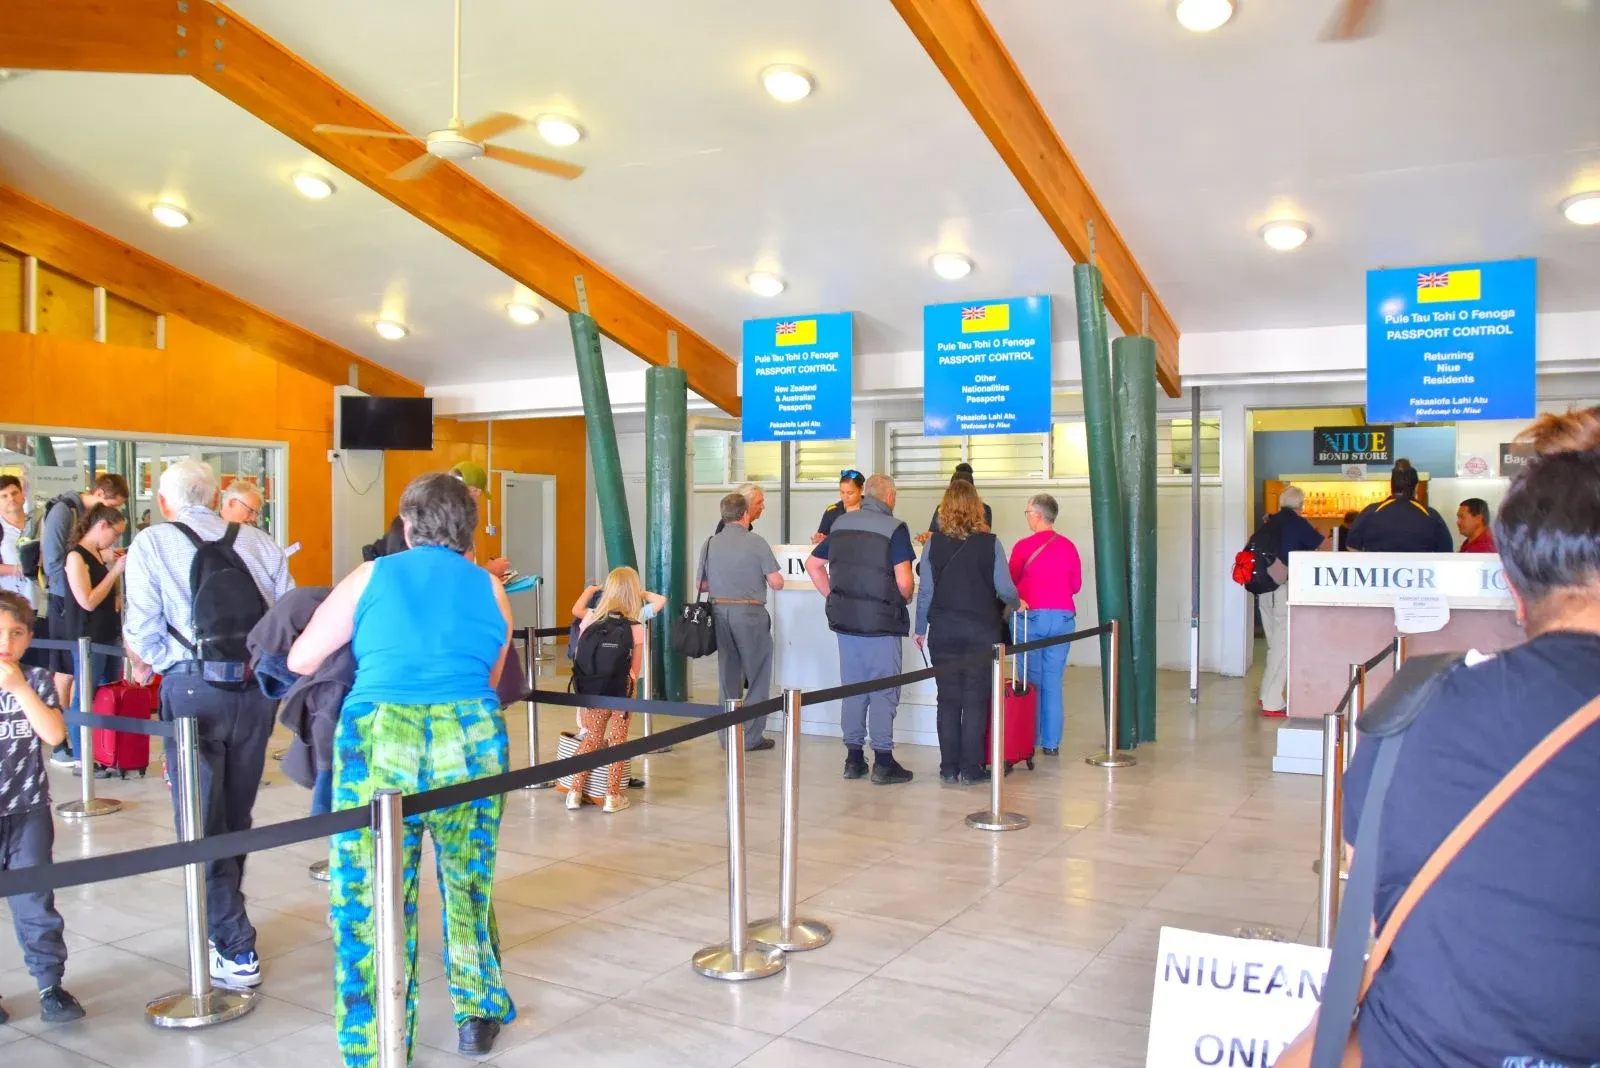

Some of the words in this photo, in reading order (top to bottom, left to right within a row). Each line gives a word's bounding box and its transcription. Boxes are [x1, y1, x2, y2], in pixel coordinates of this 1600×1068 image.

[1411, 313, 1430, 323] Tau
[1432, 311, 1456, 322] Tohi
[1459, 310, 1469, 320] O
[1472, 308, 1515, 320] Fenoga
[1386, 328, 1449, 340] PASSPORT
[1453, 325, 1513, 337] CONTROL
[957, 341, 971, 350] Tau
[973, 340, 991, 348] Tohi
[993, 339, 1000, 347] O
[1003, 338, 1035, 348] Fenoga
[785, 353, 801, 361] Tohi
[802, 352, 809, 360] O
[810, 351, 839, 360] Fenoga
[939, 354, 987, 365] PASSPORT
[988, 351, 1034, 362] CONTROL
[1424, 350, 1474, 361] Returning
[756, 366, 796, 376] PASSPORT
[798, 364, 837, 374] CONTROL
[1437, 364, 1460, 372] Niue
[975, 374, 996, 382] Other
[1423, 375, 1474, 385] Residents
[775, 385, 788, 393] New
[790, 384, 817, 392] Zealand
[962, 384, 1010, 393] Nationalities
[782, 394, 815, 402] Australian
[966, 394, 1006, 404] Passports
[1452, 396, 1471, 405] Lahi
[1473, 396, 1488, 404] Atu
[778, 404, 812, 412] Passports
[1322, 432, 1386, 452] NIUE
[1320, 452, 1349, 460] BOND
[1351, 452, 1388, 460] STORE
[1194, 1034, 1289, 1068] ONL
